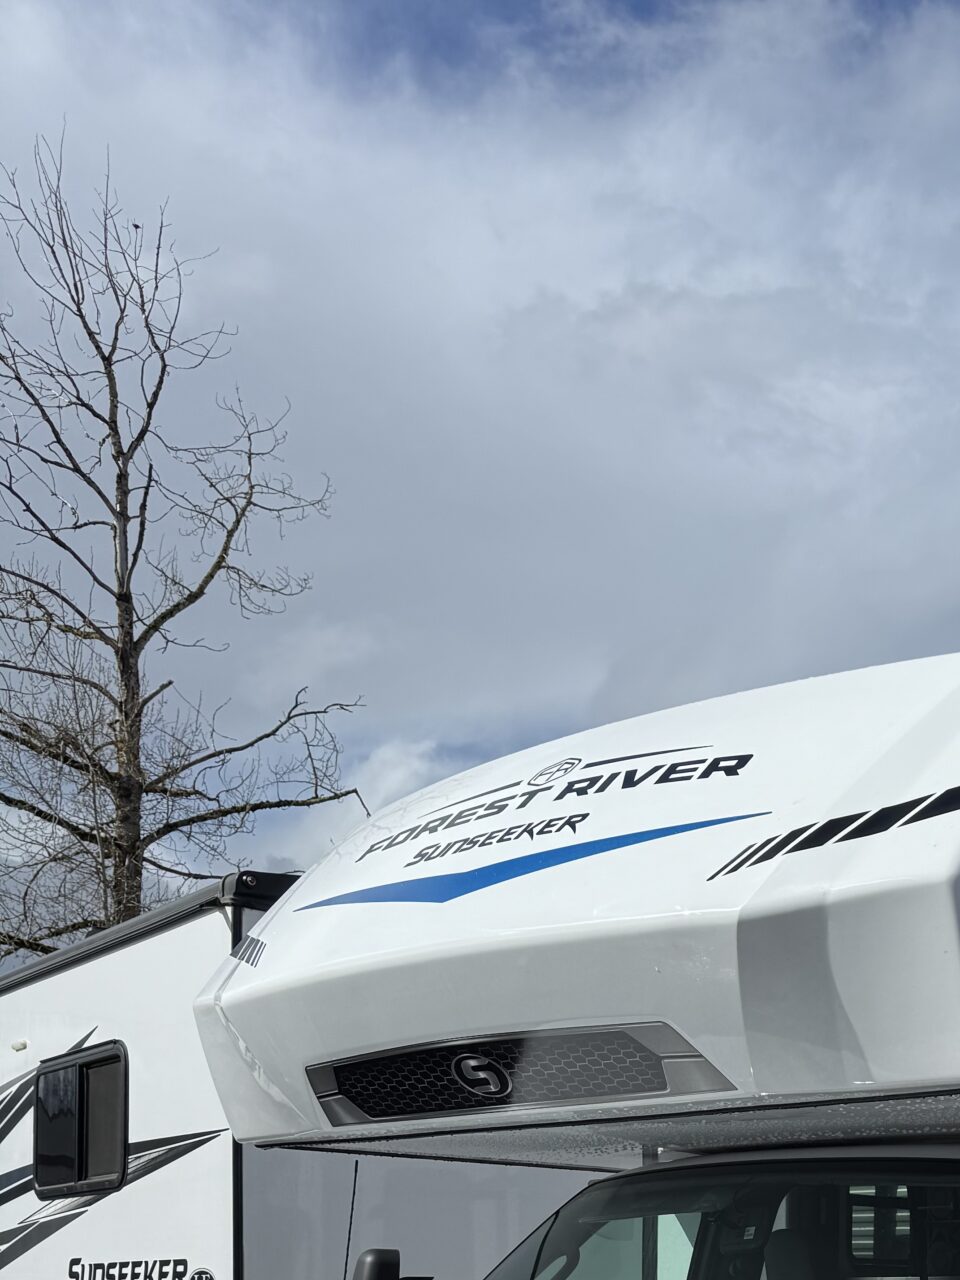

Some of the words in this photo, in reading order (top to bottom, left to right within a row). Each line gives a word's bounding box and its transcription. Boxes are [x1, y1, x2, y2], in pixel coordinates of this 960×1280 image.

[355, 787, 552, 863] FOREST
[553, 754, 754, 802] RIVER
[403, 812, 590, 868] SUNSEEKER
